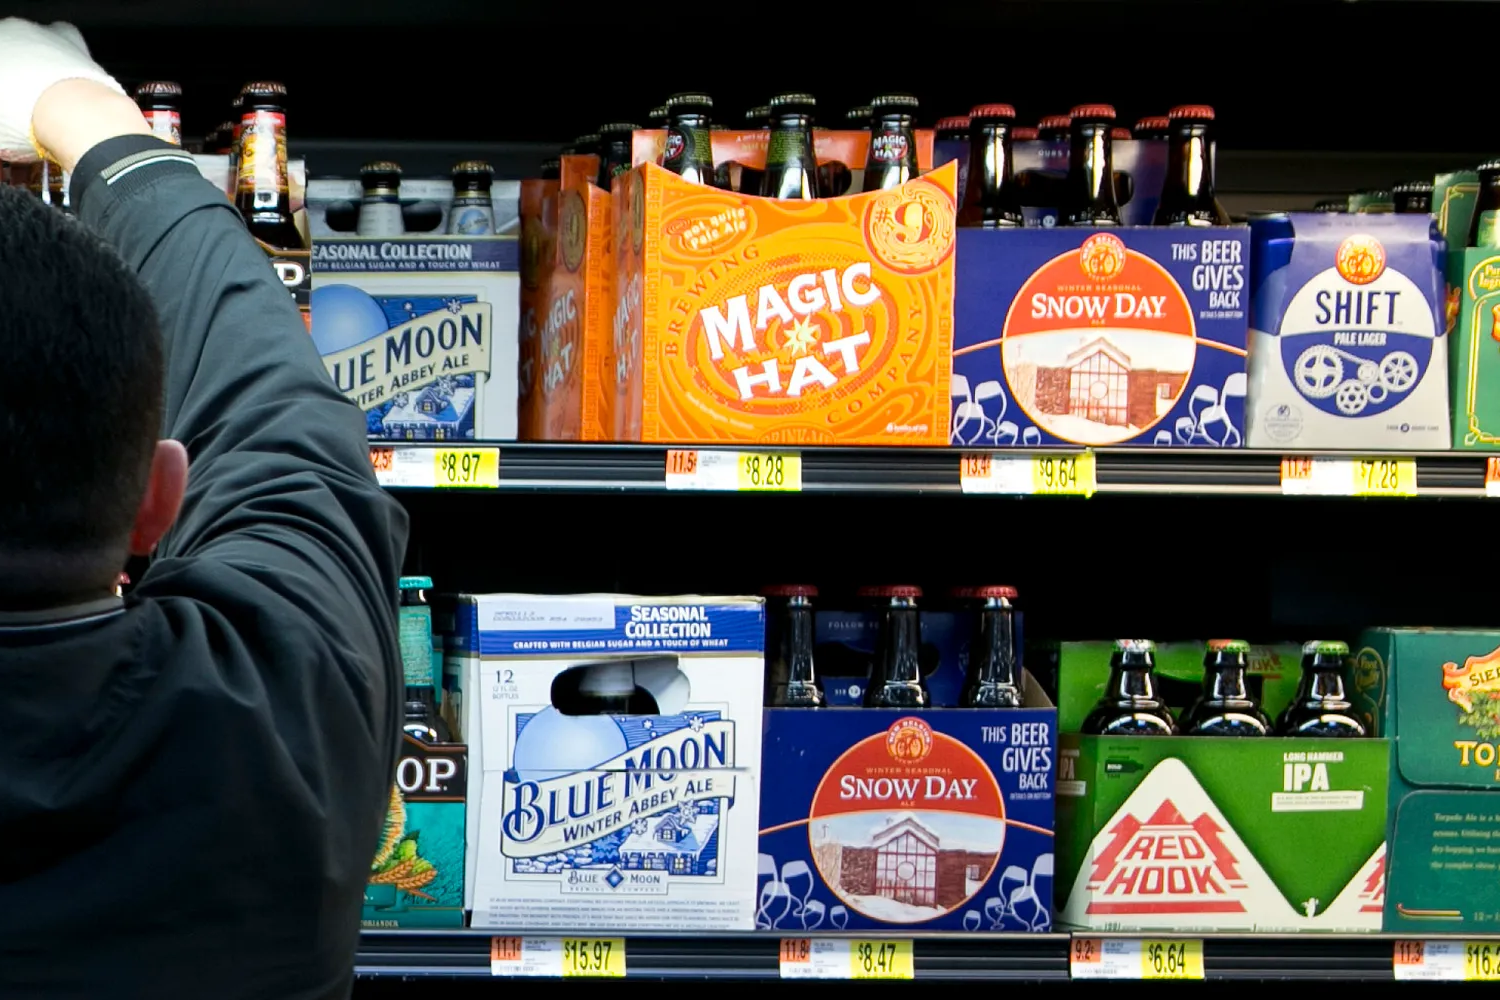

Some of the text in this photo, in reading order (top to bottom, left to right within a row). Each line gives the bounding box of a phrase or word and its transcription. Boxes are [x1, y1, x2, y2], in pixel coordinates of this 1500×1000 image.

[312, 242, 472, 260] EASONAL COLLECTION
[1171, 240, 1241, 264] THIS BEER
[1192, 265, 1244, 291] GIVES
[665, 244, 760, 358] BREWING
[700, 262, 881, 360] MAGIC
[1031, 293, 1166, 319] SNOW DAY
[1209, 292, 1240, 309] BACK
[1316, 290, 1401, 325] SHIFT
[384, 313, 484, 374] MOON
[1334, 332, 1387, 346] PALE LAGER
[390, 362, 437, 388] ABBEY
[442, 353, 470, 370] ALE
[733, 330, 871, 401] HAT
[825, 305, 922, 425] COMPANY
[442, 453, 481, 482] $8.97
[746, 455, 784, 486] $8.28
[1040, 457, 1077, 487] $9.64
[1361, 461, 1398, 489] $7.28
[631, 605, 708, 622] SEASONAL
[513, 641, 548, 649] CRAFTED
[550, 641, 570, 649] WITH
[607, 640, 633, 648] SUGAR
[635, 640, 652, 648] AND
[662, 639, 688, 647] TOUCH
[702, 638, 728, 646] WHEAT
[625, 622, 711, 639] COLLECTION
[495, 670, 514, 684] 12
[982, 723, 1049, 746] THIS BEER
[1003, 747, 1051, 772] GIVES
[502, 731, 732, 842] BLUE MOON
[840, 775, 977, 800] SNOW DAY
[1019, 772, 1048, 790] BACK
[1284, 764, 1330, 791] IPA
[562, 778, 713, 844] WINTER ABBEY ALE
[1123, 835, 1206, 861] RED
[567, 870, 660, 885] BLUE MOON
[1103, 866, 1227, 895] HOOK
[565, 941, 612, 971] $15.97
[859, 944, 896, 973] $8.47
[1148, 944, 1186, 973] $6.64
